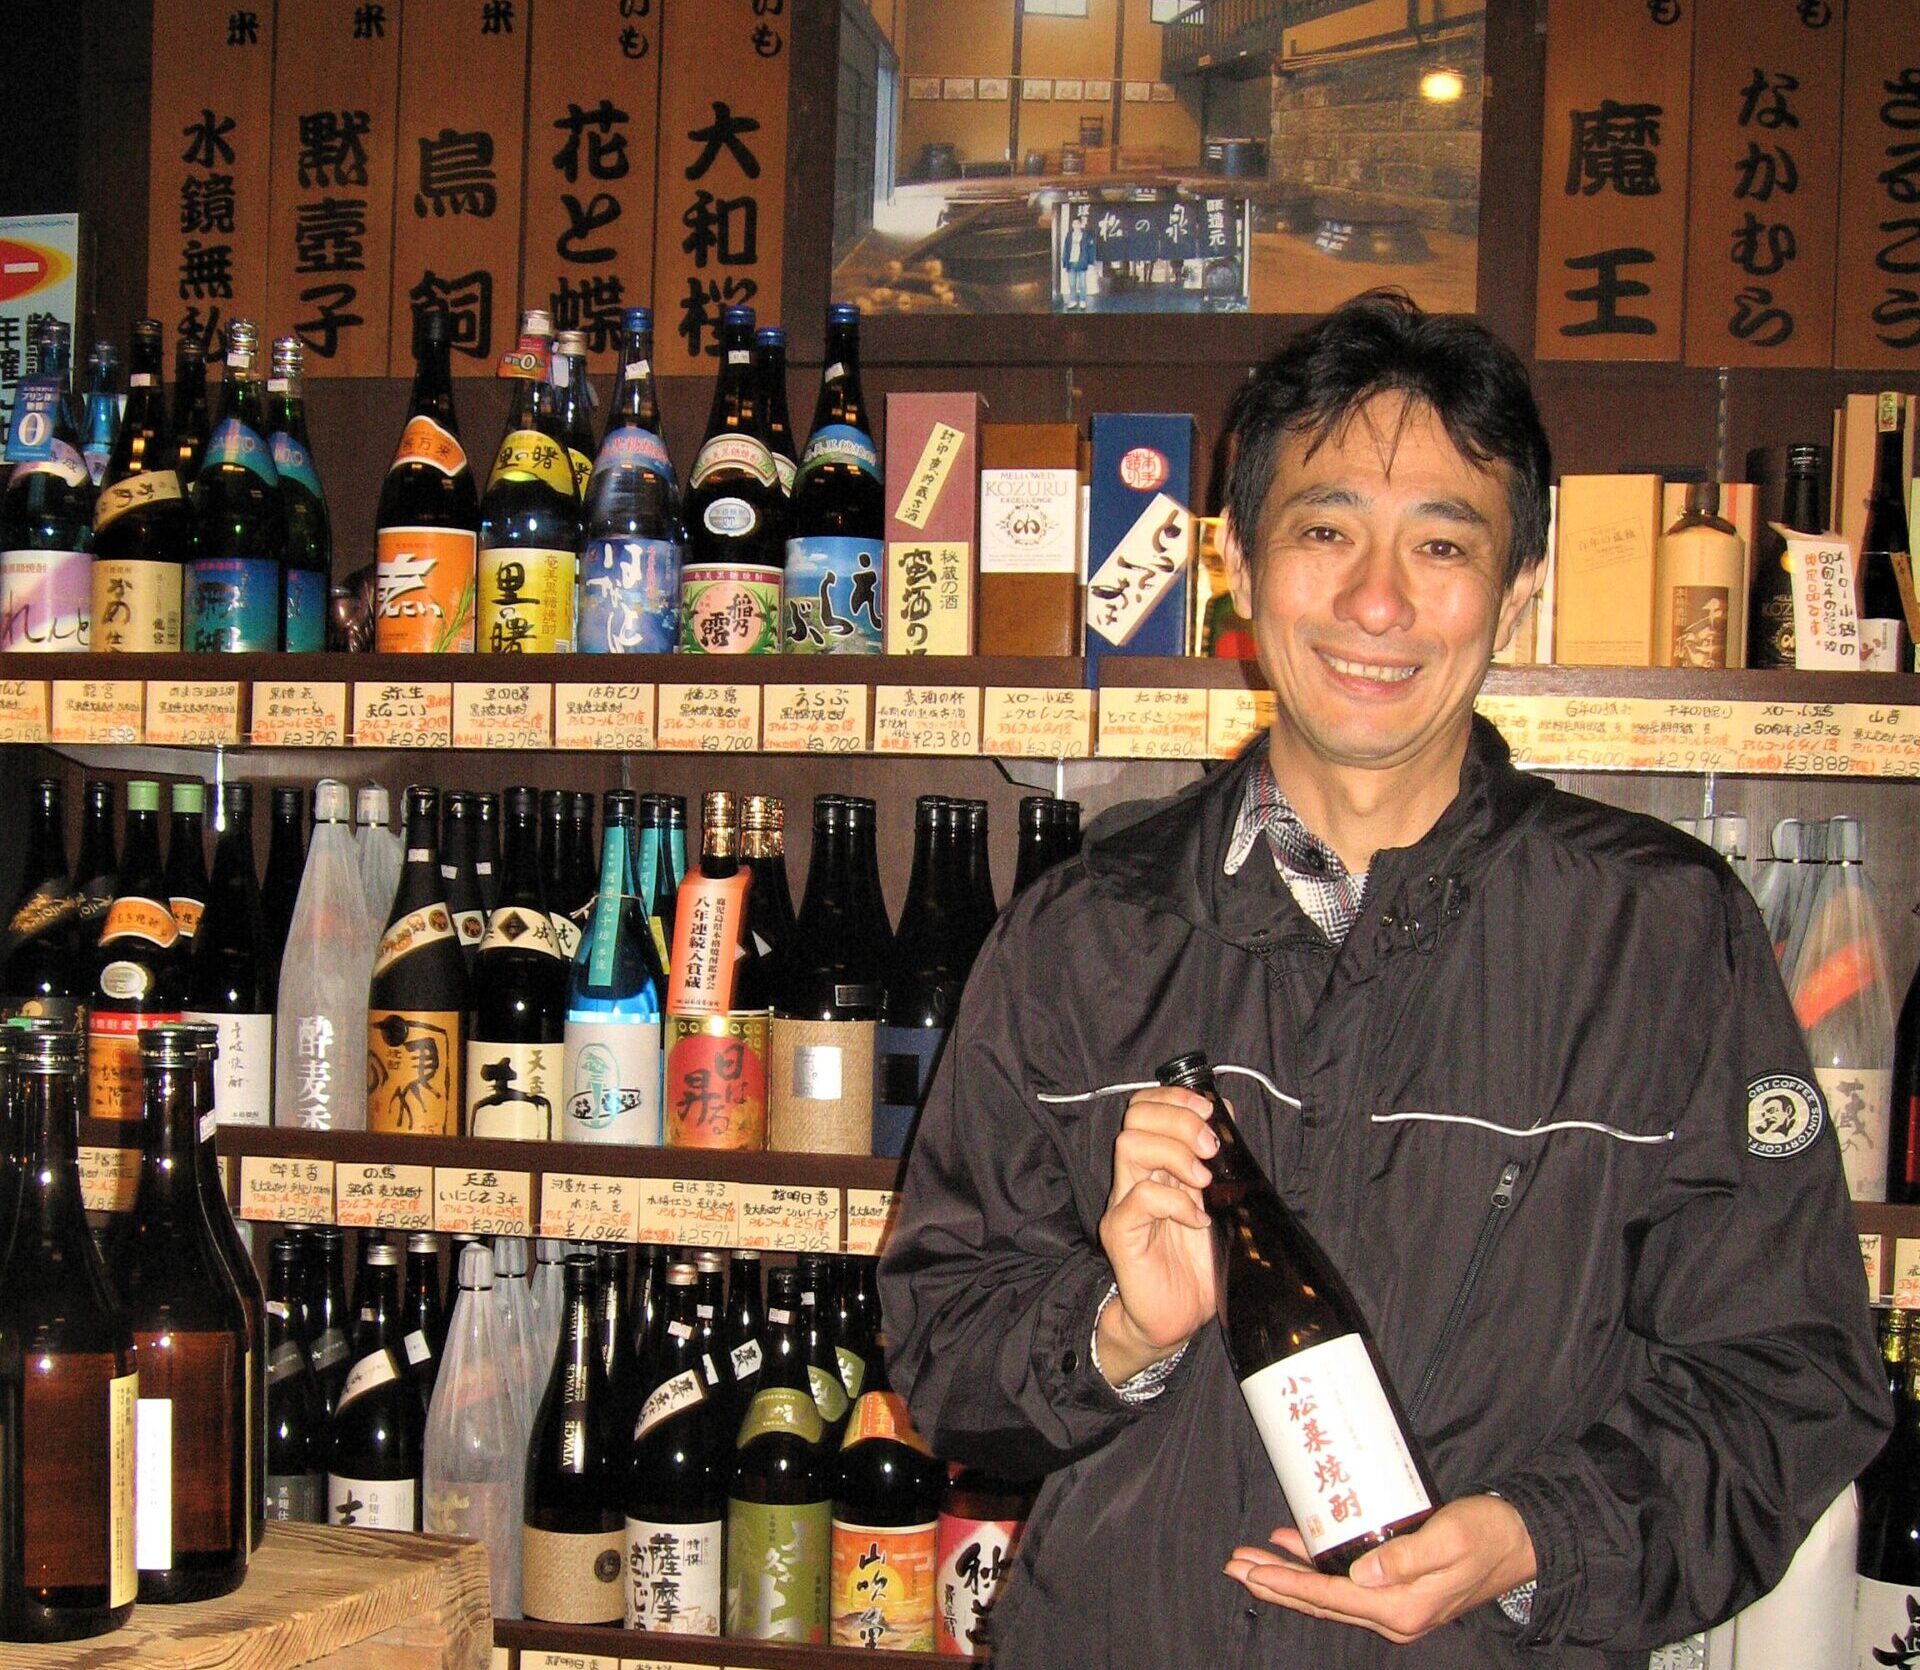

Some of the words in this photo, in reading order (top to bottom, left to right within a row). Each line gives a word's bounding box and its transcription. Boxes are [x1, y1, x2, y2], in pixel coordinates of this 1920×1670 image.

[551, 100, 630, 354] 花と蝶
[1559, 99, 1663, 337] 魔王
[1728, 67, 1800, 347] なかむら
[985, 480, 1068, 497] KOZURU
[1000, 471, 1056, 480] MELLOWED
[938, 549, 960, 611] 秘蔵の酒
[684, 896, 711, 990] 八年連続入賞蔵
[568, 1301, 579, 1341] VIVACE
[564, 1362, 578, 1404] VIVACE
[563, 1419, 577, 1467] VIVACE
[1282, 1375, 1362, 1524] 小松菜焼酎
[650, 1533, 683, 1623] 薩摩
